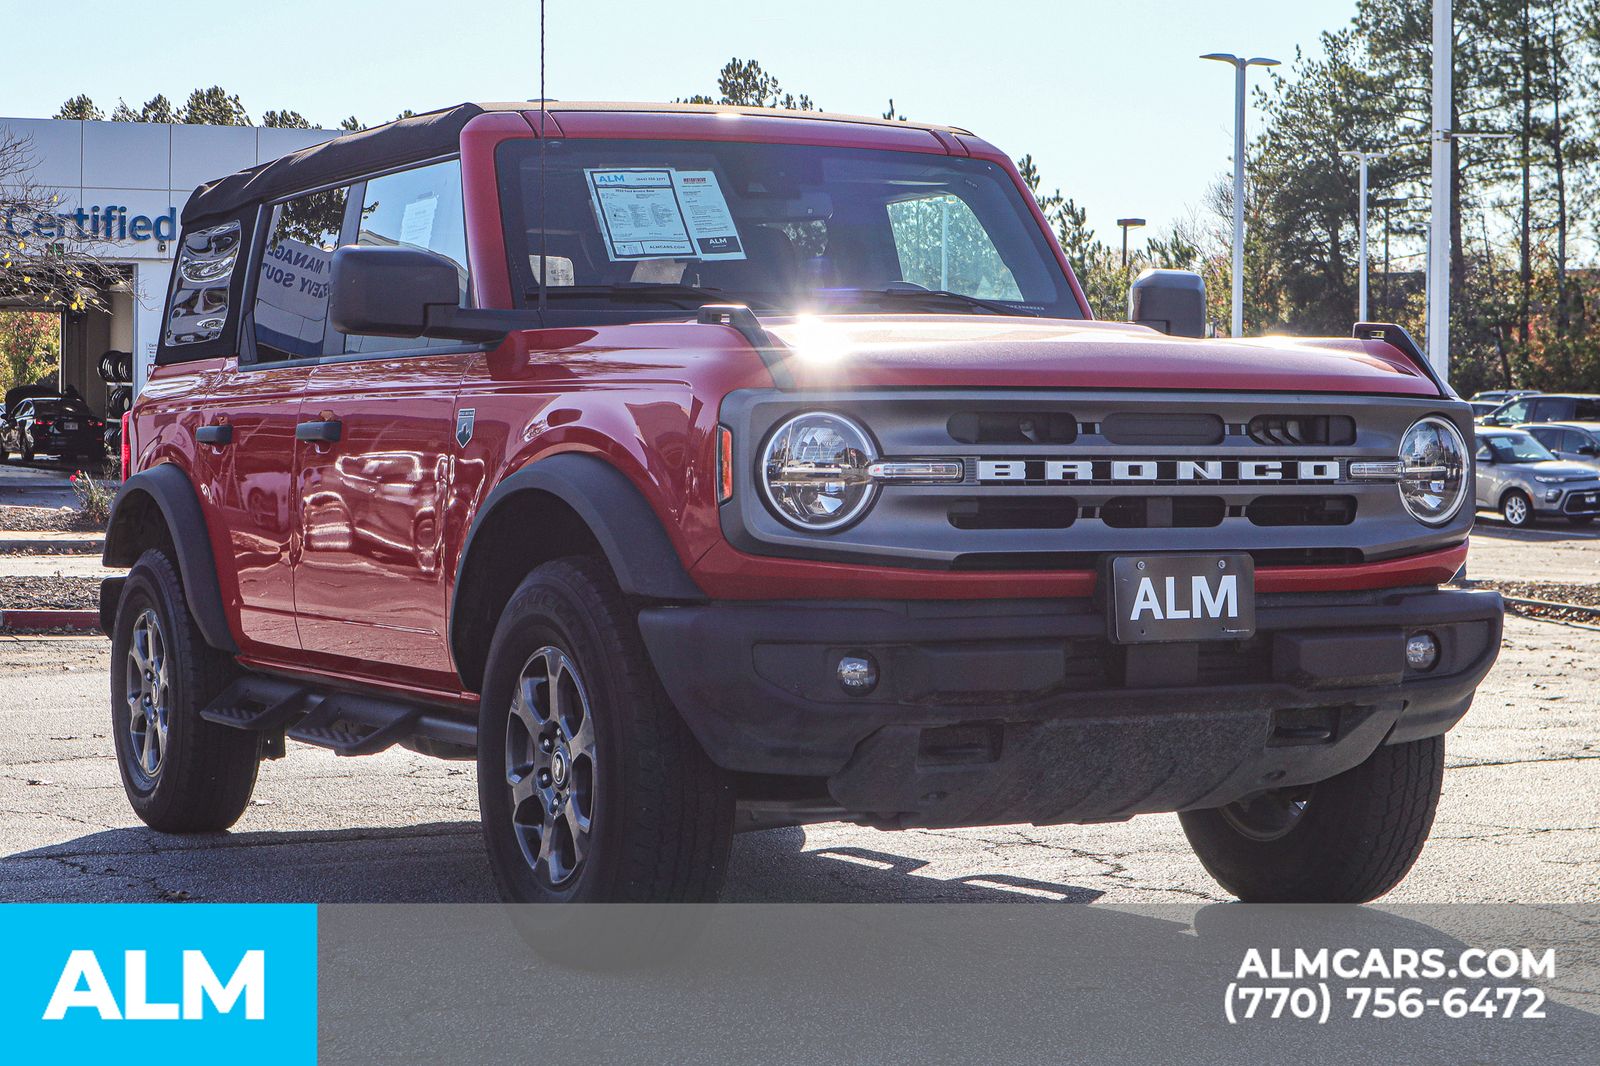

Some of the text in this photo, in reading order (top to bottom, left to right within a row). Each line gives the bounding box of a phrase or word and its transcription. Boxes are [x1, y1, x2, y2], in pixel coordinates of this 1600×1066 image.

[599, 174, 625, 183] ALM
[5, 205, 177, 241] Certified
[709, 237, 728, 245] ALM
[977, 460, 1340, 480] BRONCO
[1130, 574, 1238, 621] ALM
